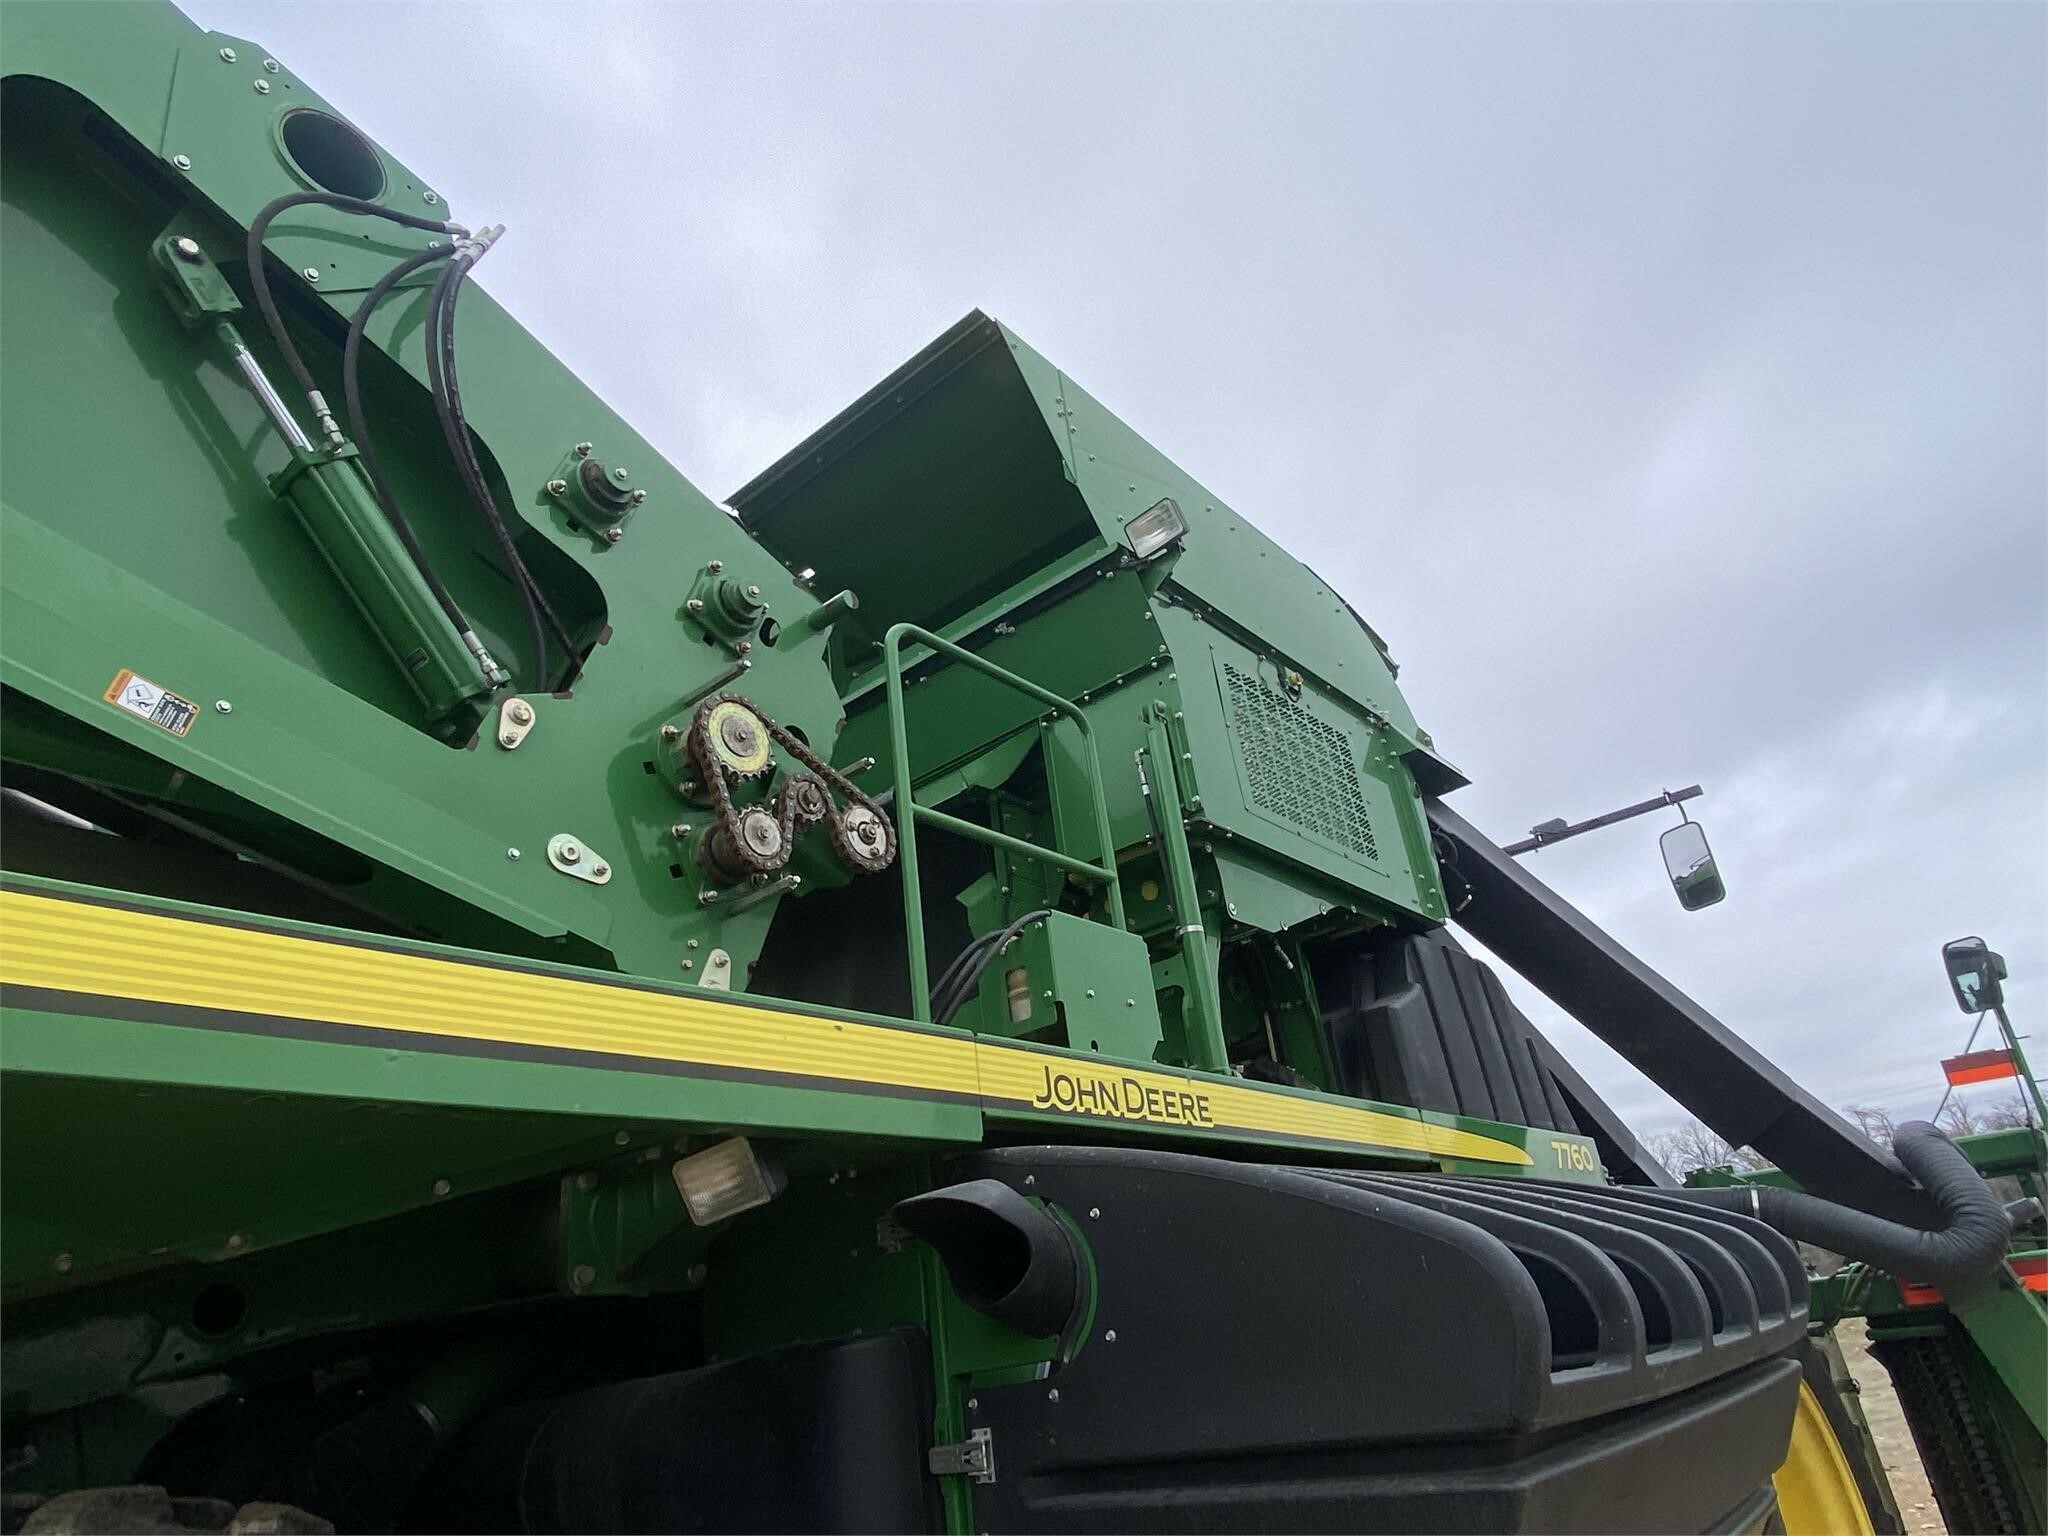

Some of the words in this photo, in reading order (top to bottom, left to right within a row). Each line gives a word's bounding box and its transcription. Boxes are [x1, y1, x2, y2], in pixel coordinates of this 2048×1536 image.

[1035, 1065, 1120, 1112] JOHN
[1121, 1077, 1213, 1124] DEERE
[1550, 1141, 1594, 1171] 7760
